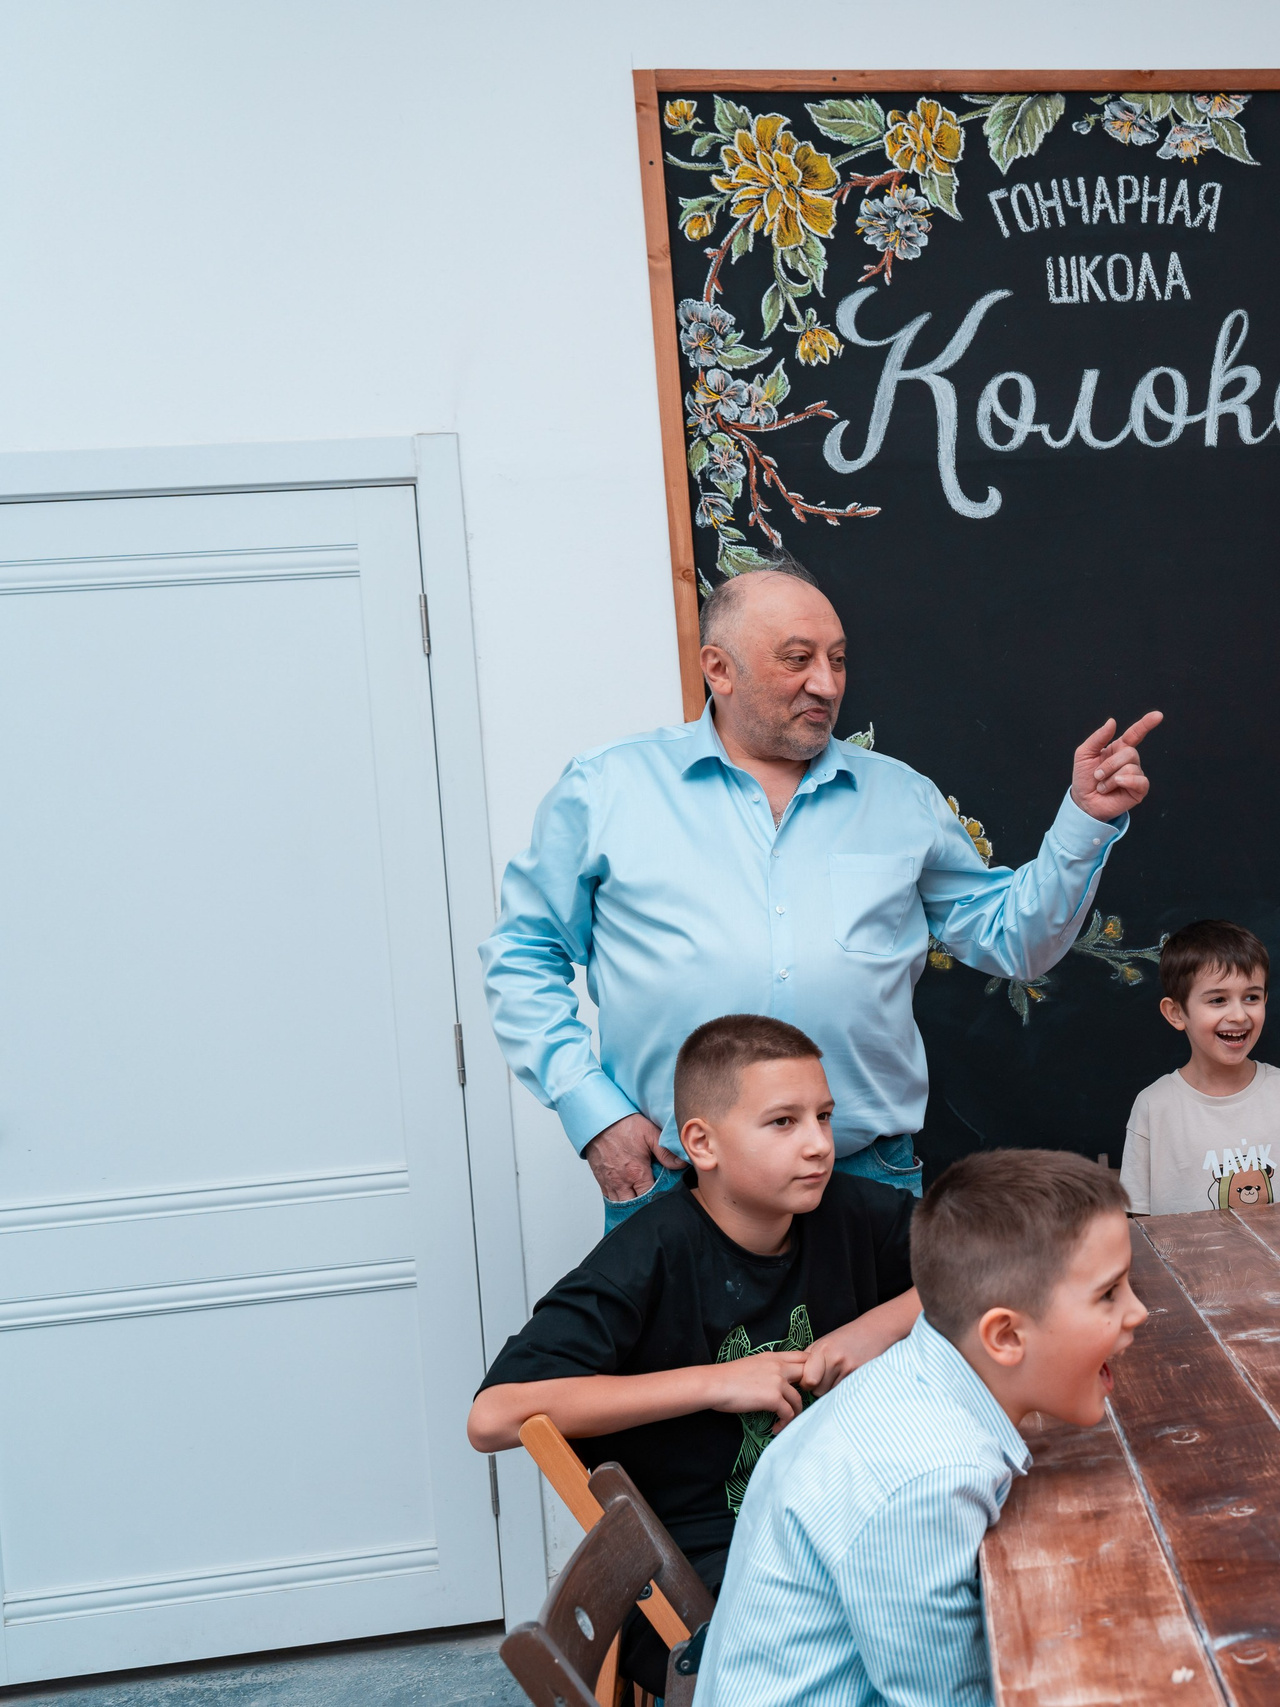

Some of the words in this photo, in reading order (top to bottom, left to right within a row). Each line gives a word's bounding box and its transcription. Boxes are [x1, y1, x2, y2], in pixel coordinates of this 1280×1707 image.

[988, 174, 1223, 238] ГОНЧАРНАЯ
[1046, 251, 1192, 305] ШКОЛА
[1202, 1138, 1278, 1179] ЛАЙК
